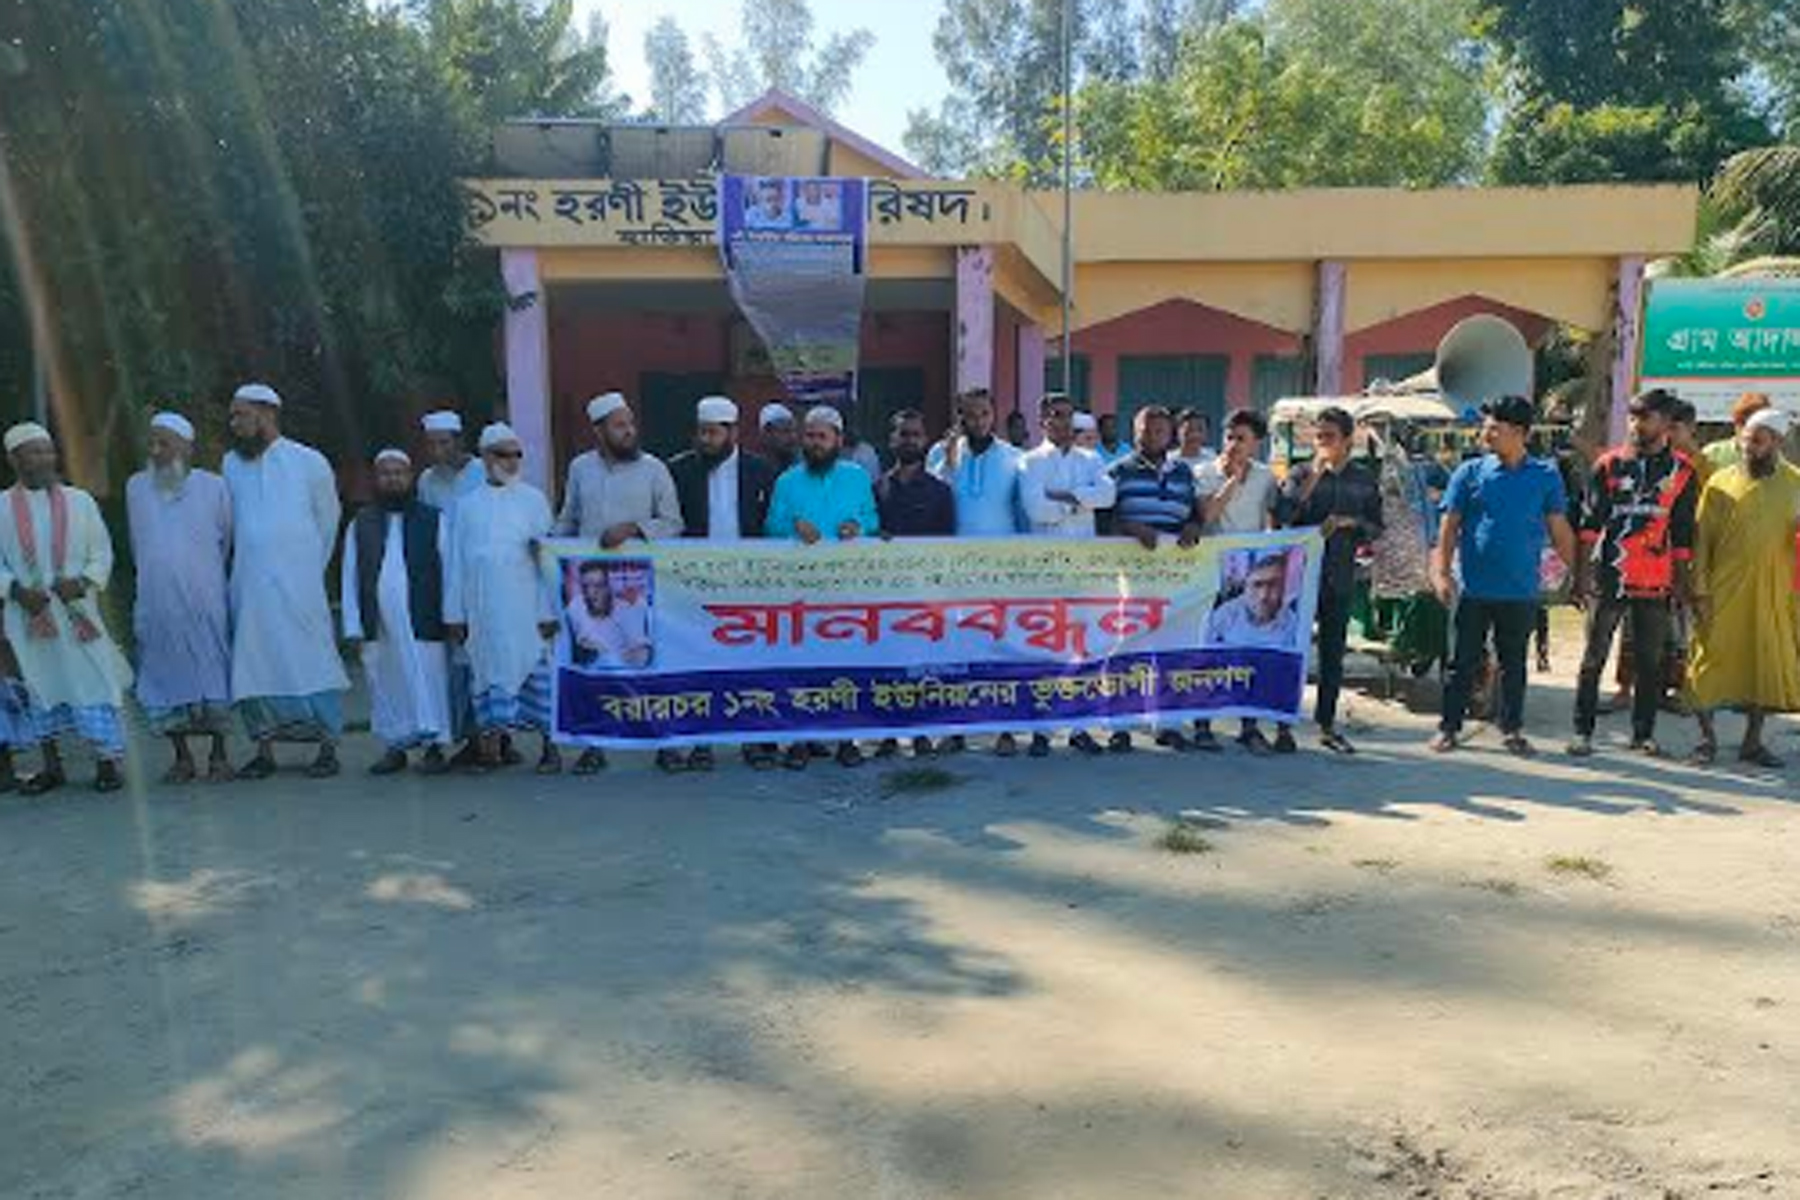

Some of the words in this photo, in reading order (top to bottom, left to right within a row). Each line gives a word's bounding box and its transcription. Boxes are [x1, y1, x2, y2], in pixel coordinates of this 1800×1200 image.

[551, 182, 647, 224] হরণী
[868, 178, 990, 223] রিষদ।
[702, 597, 1171, 657] মানববন্ধন
[724, 689, 781, 717] ১নং
[788, 677, 862, 713] হরণী
[871, 673, 1021, 709] ইউনিয়নের
